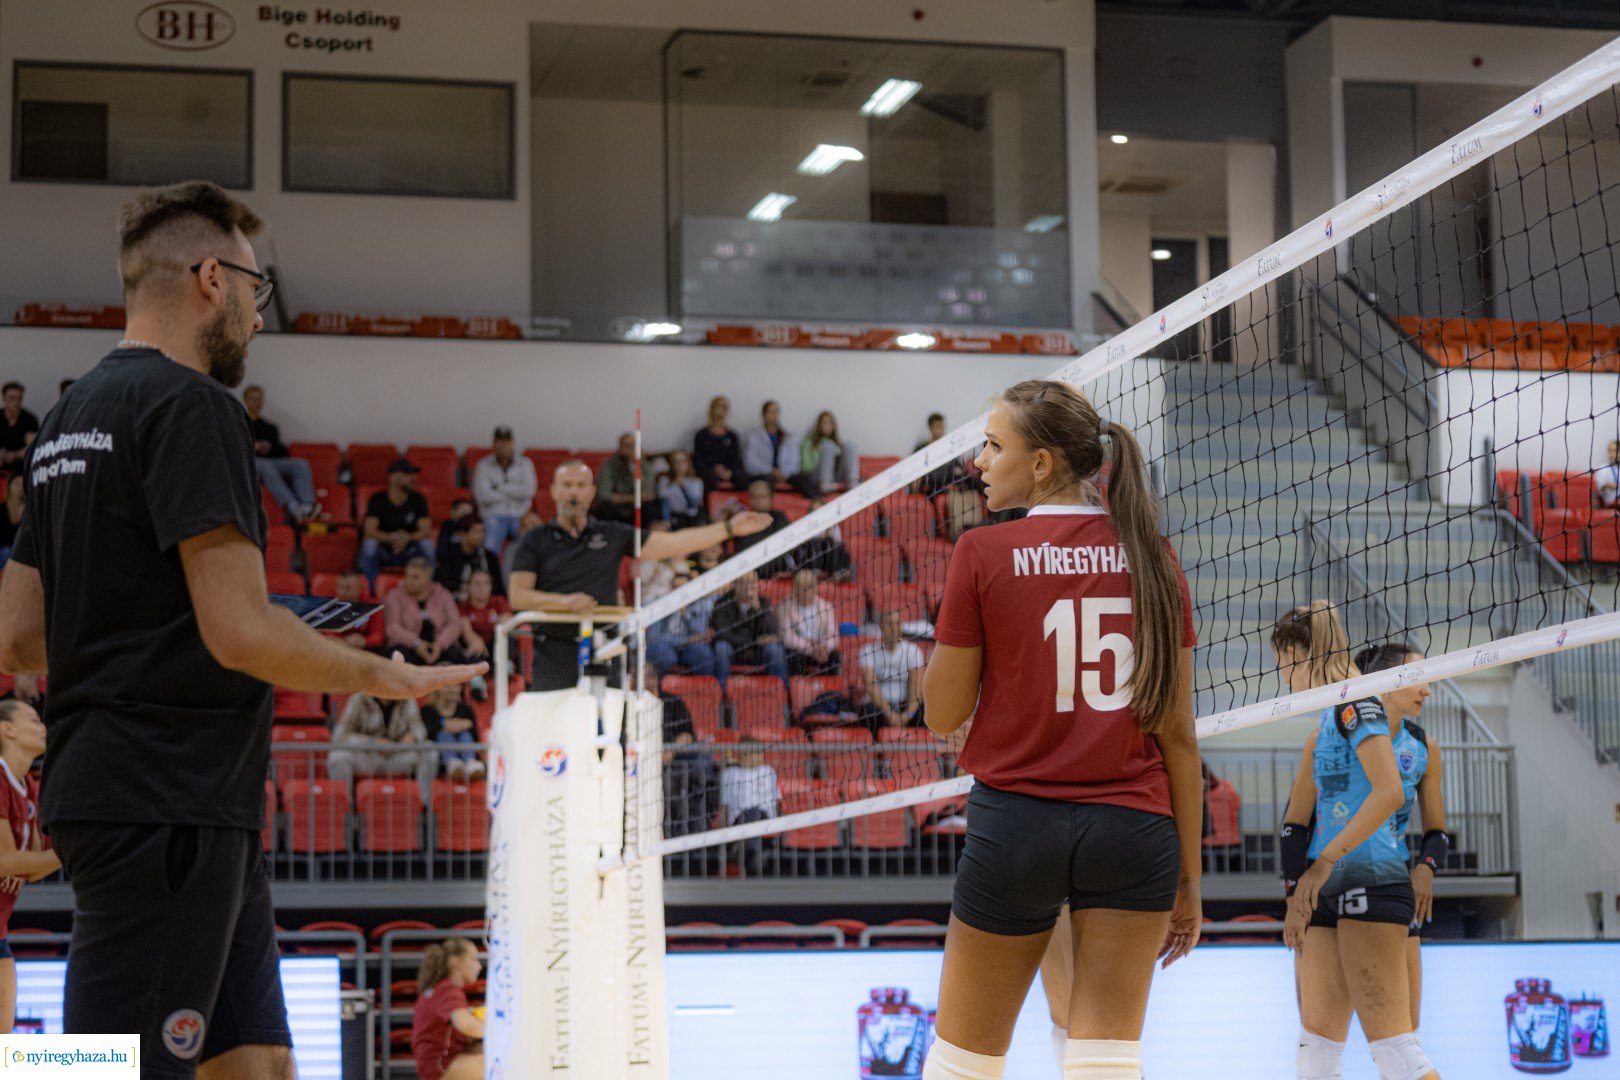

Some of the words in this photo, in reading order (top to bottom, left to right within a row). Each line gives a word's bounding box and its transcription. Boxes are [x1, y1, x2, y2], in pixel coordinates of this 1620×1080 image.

[157, 9, 216, 41] BH
[258, 5, 307, 26] Bige
[315, 8, 401, 30] Holding
[285, 32, 374, 52] Csoport
[1043, 596, 1135, 713] 15
